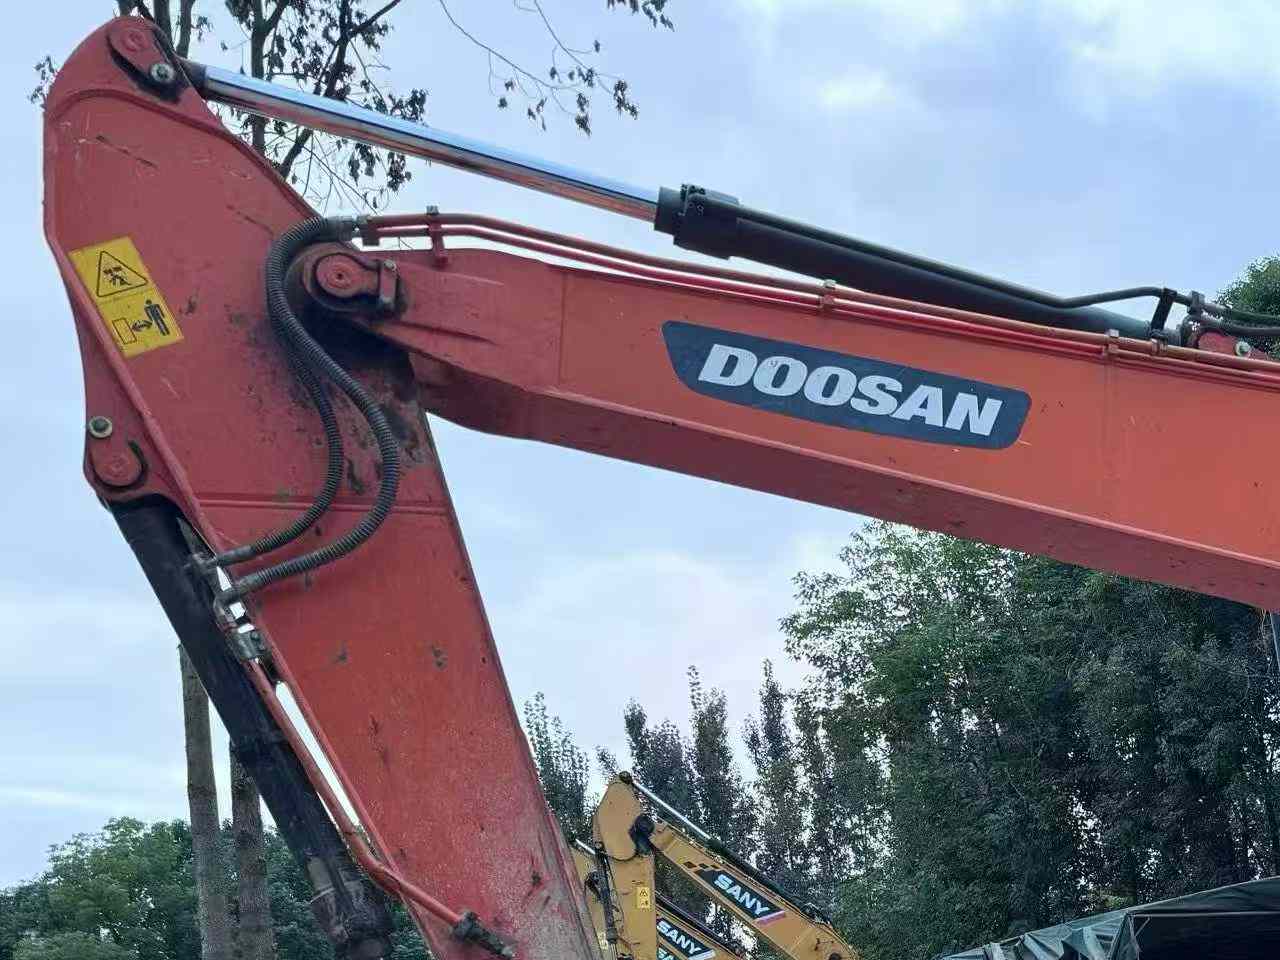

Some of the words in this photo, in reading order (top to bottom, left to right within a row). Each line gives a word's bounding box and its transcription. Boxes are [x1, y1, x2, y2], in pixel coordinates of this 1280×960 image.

[698, 343, 1003, 436] DOOSAN
[713, 873, 770, 916] SANY
[656, 920, 701, 955] SANY
